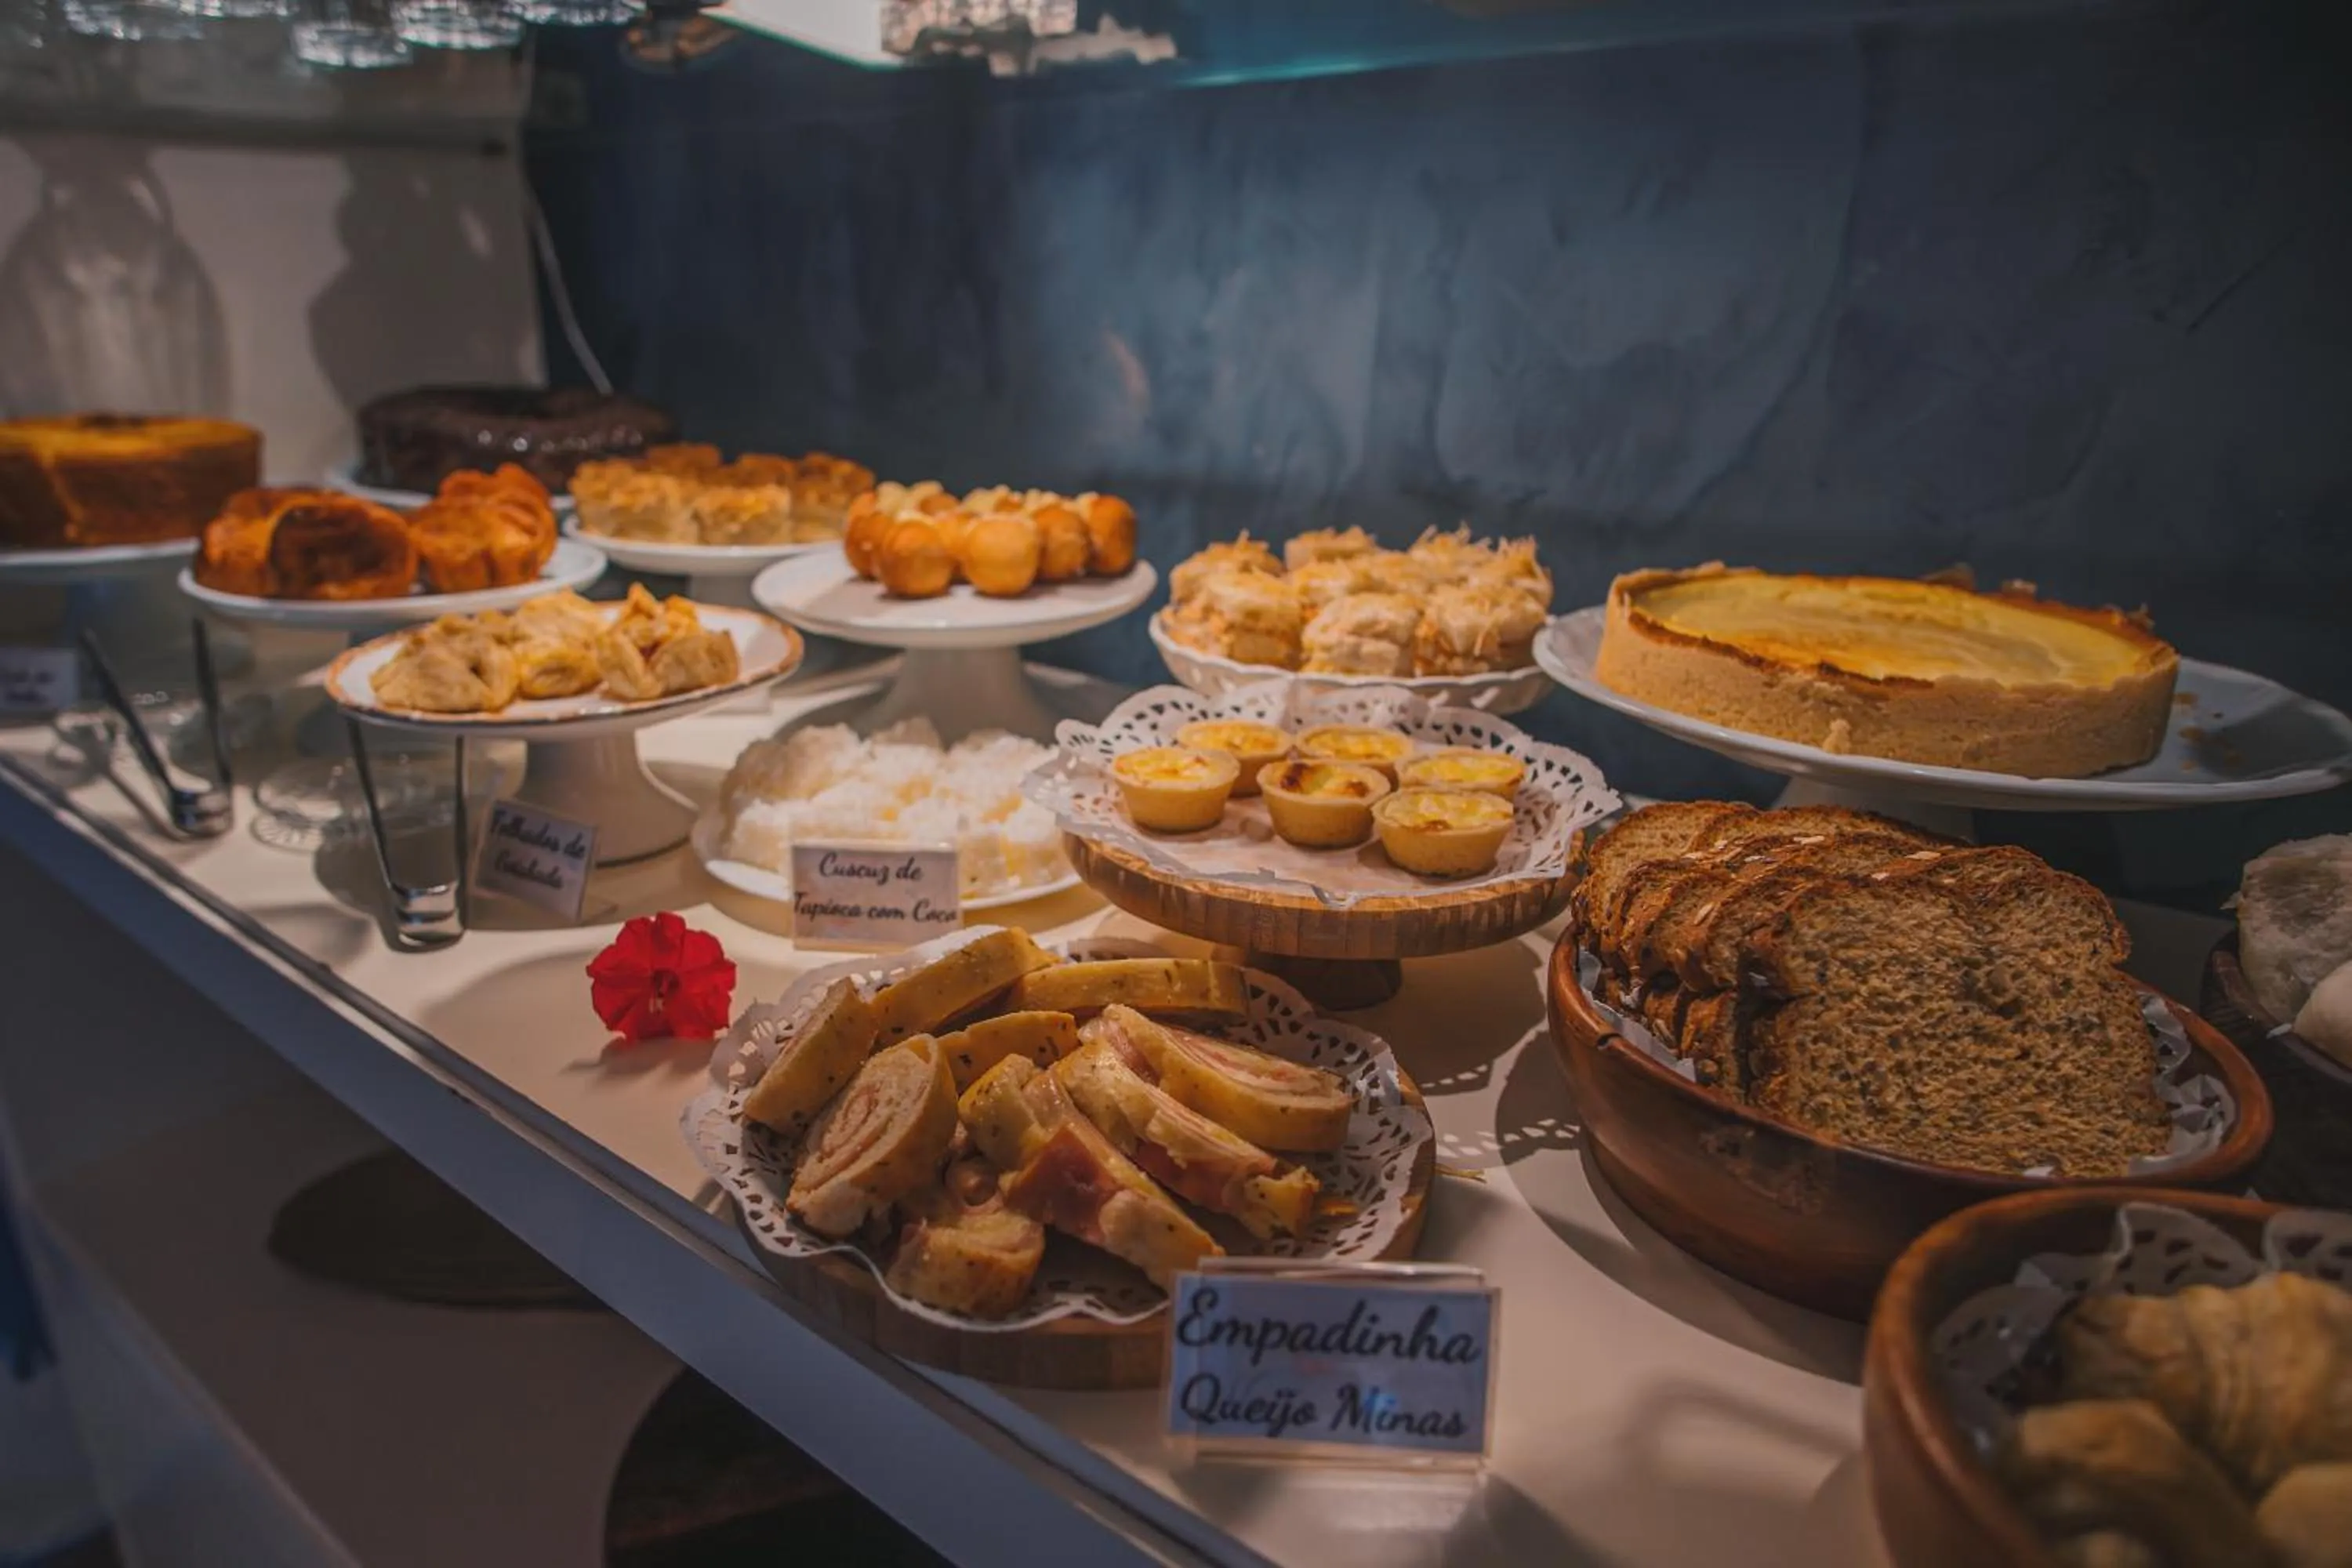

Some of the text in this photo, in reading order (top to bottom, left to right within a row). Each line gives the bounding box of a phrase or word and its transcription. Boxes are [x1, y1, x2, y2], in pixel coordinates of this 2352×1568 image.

[819, 851, 924, 885] Cuscuz de
[793, 891, 958, 923] Tapioca com Coco
[1178, 1287, 1481, 1365] Empadinha
[1179, 1372, 1468, 1438] Queijo Minas
